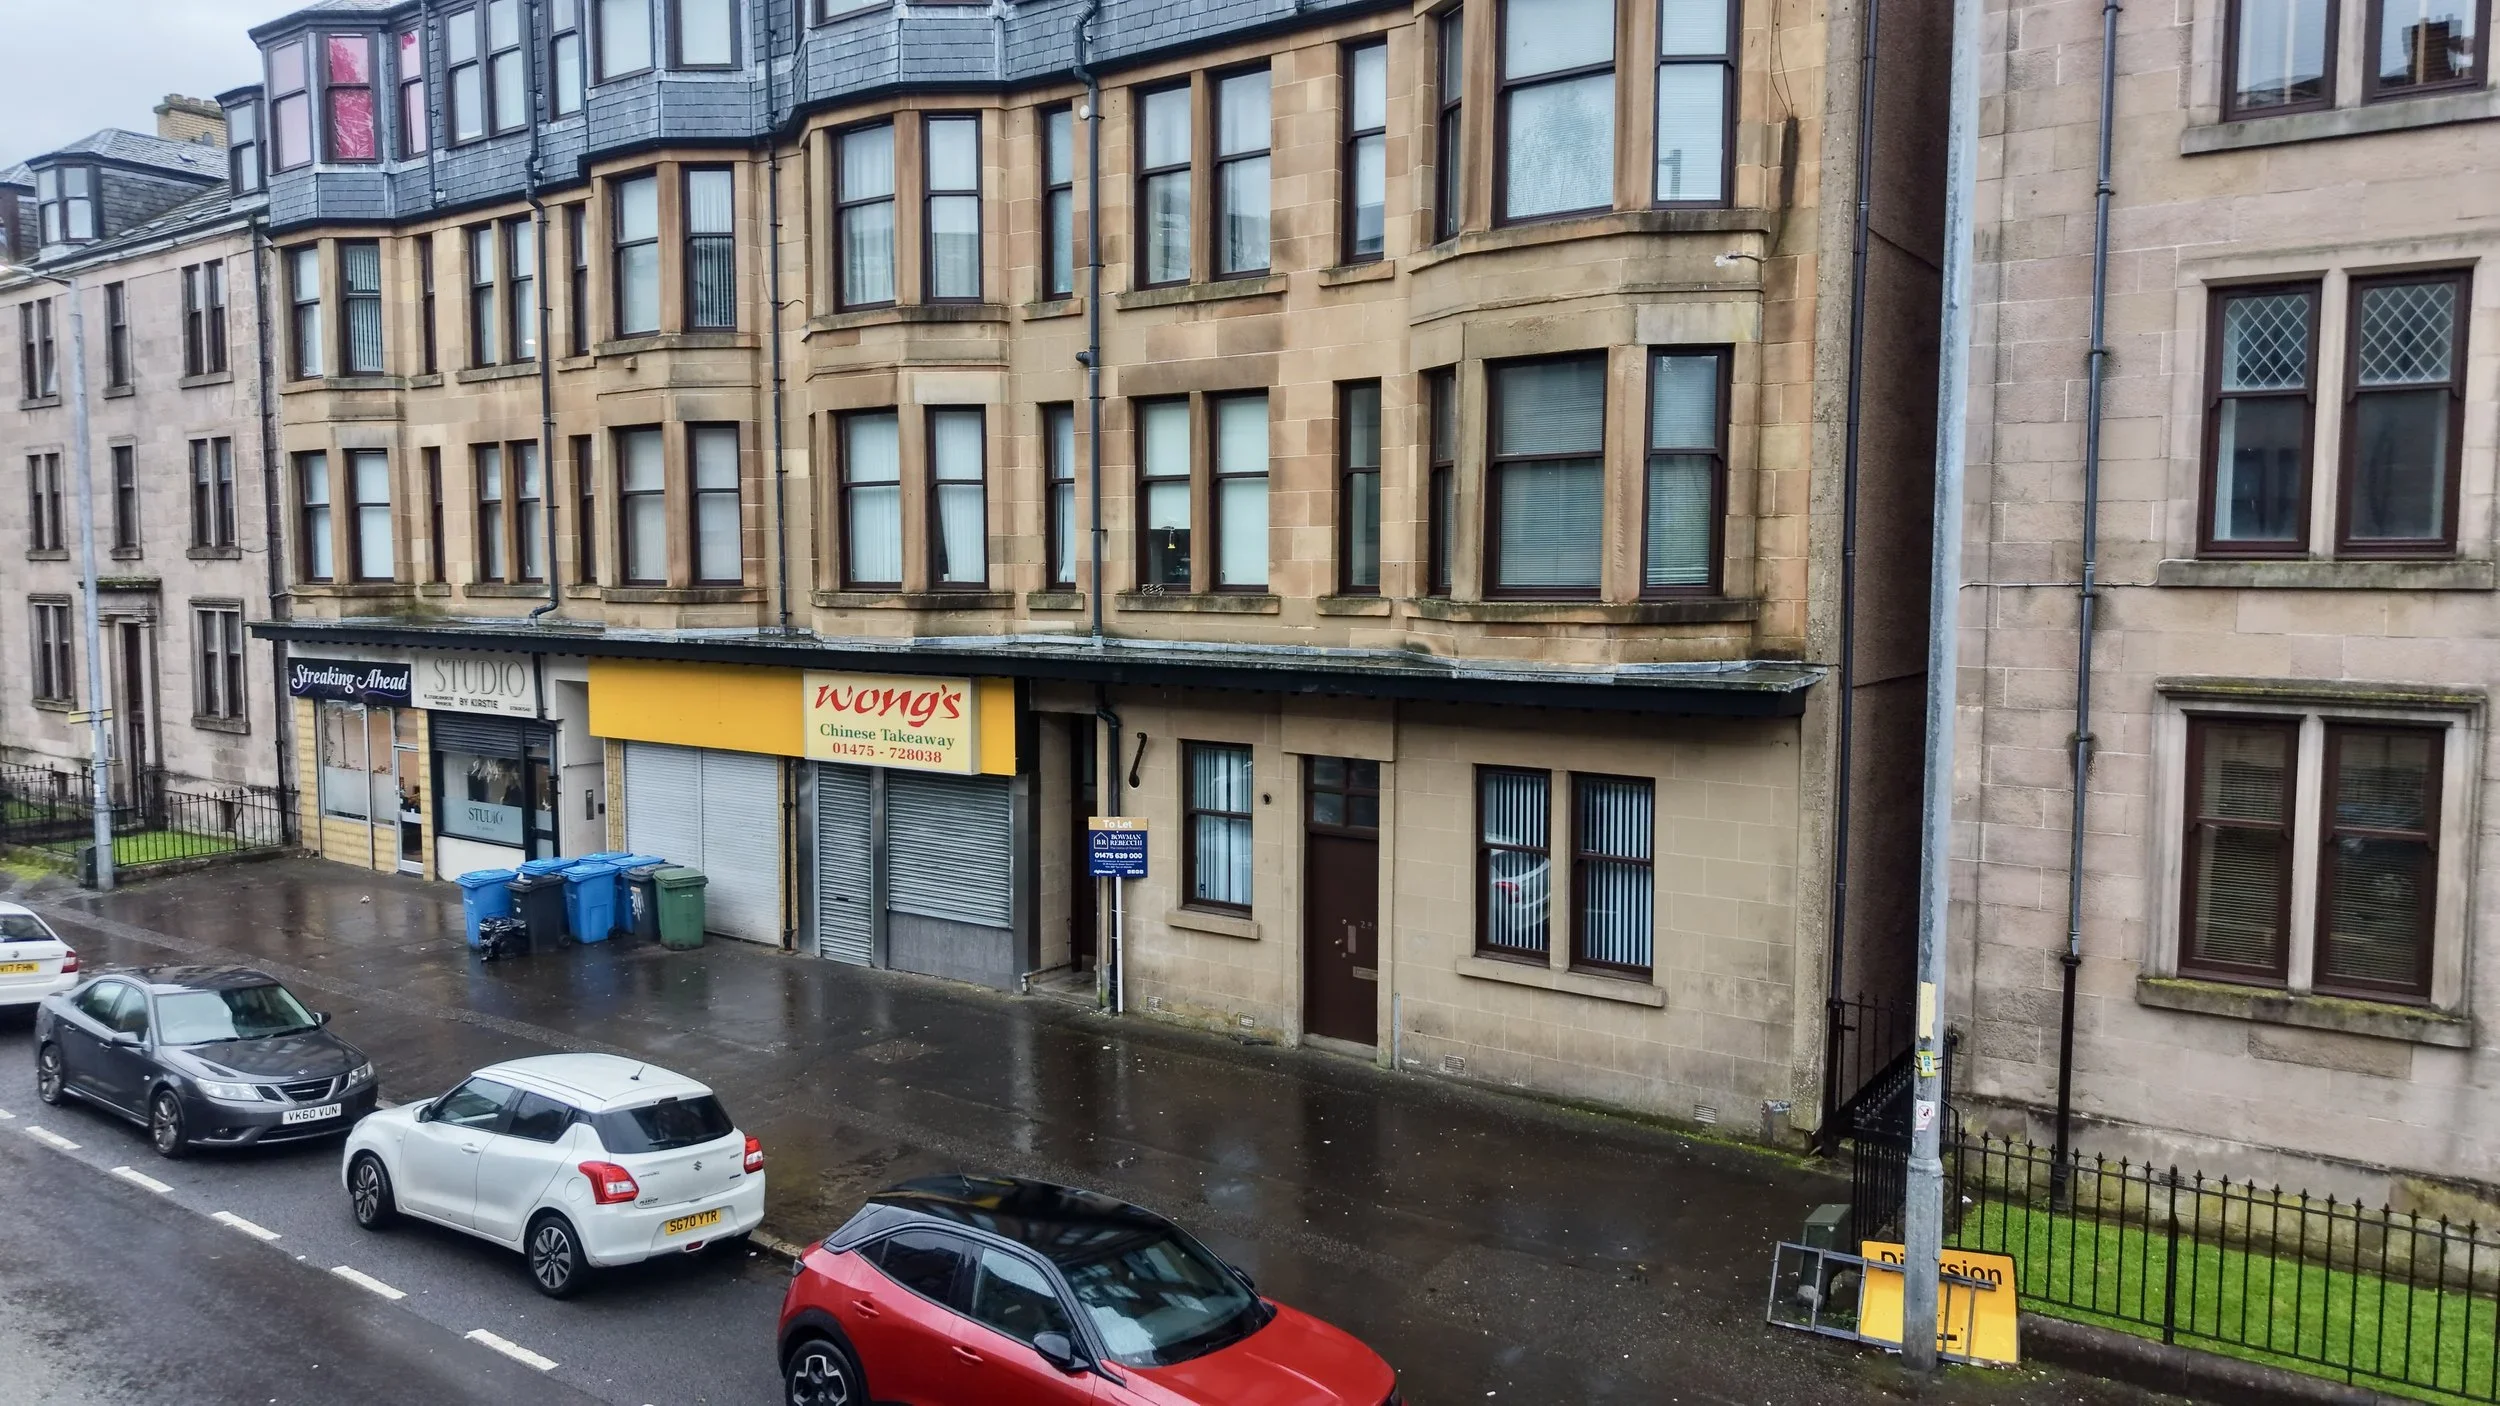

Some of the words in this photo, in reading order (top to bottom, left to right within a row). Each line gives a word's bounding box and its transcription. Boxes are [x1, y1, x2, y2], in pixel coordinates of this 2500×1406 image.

[291, 664, 355, 694] Streaking
[356, 669, 408, 691] Ahead
[434, 657, 525, 697] STUDIO
[459, 697, 468, 706] BY
[470, 698, 499, 709] KIRSTIE
[820, 723, 876, 740] Chinese
[880, 728, 955, 750] Takeaway
[832, 742, 875, 757] 01475
[889, 747, 942, 763] 728038
[1103, 820, 1115, 828] To
[1117, 820, 1132, 829] Let
[288, 1109, 316, 1121] VK60
[319, 1105, 338, 1117] VUN
[669, 1217, 696, 1232] SG70
[699, 1210, 717, 1225] YTR
[1880, 1250, 2003, 1285] Dirsion
